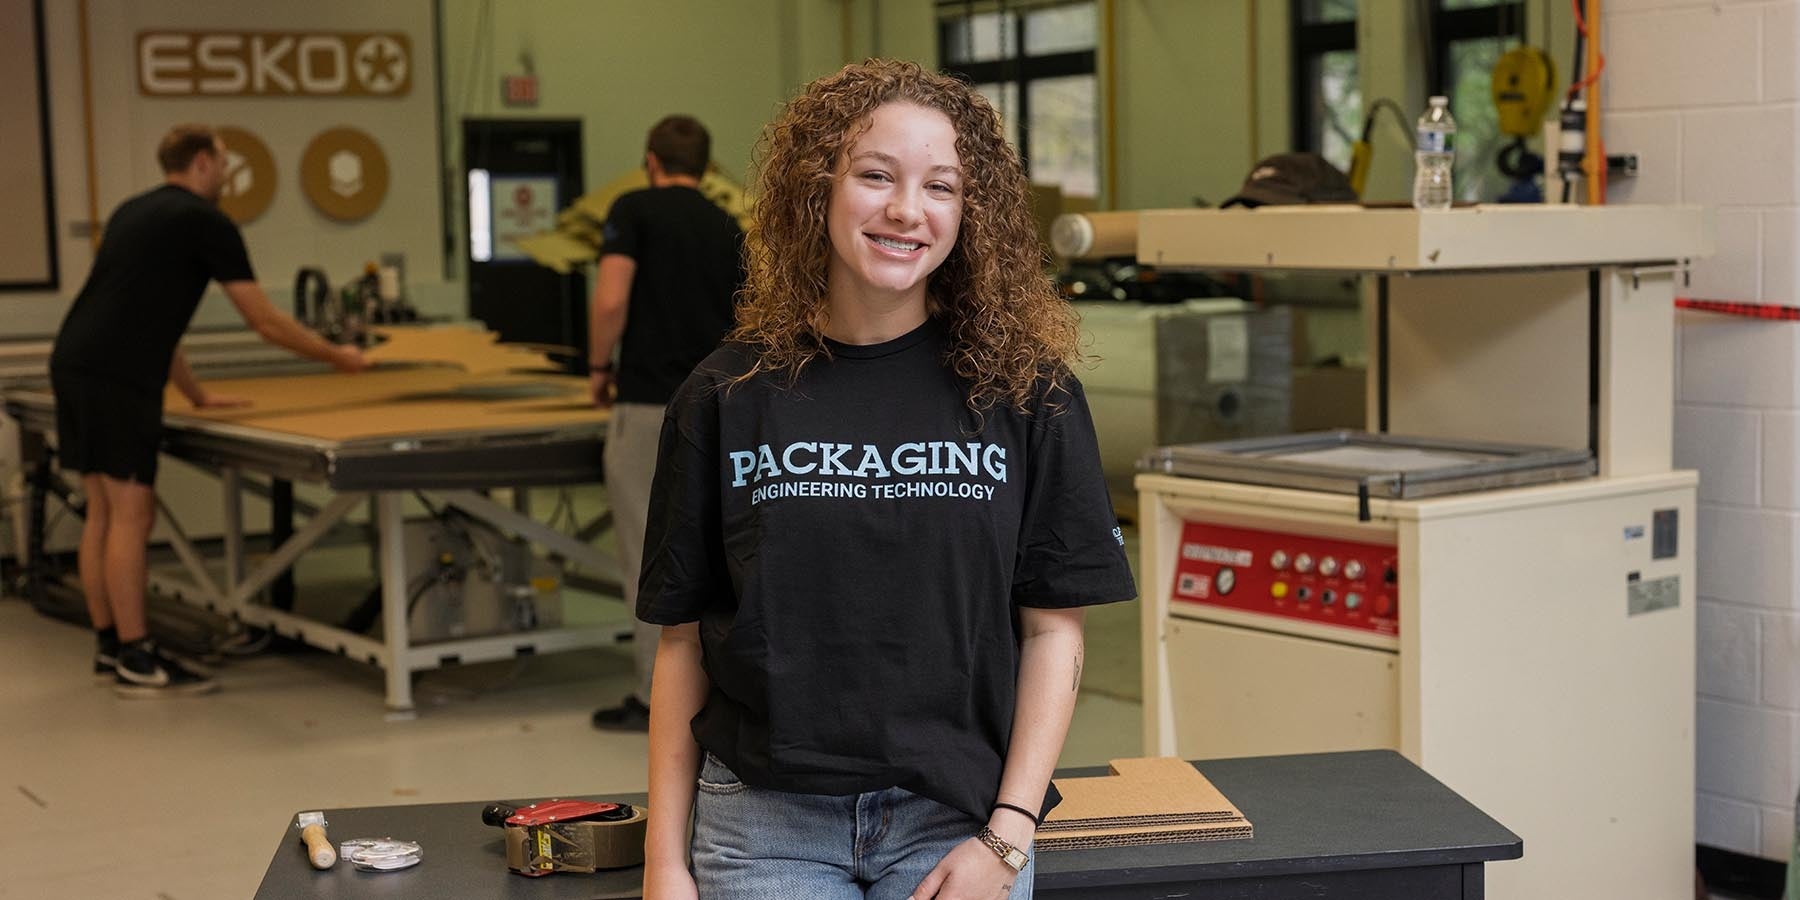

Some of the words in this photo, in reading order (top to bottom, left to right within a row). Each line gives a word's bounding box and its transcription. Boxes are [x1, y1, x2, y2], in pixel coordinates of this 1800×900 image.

[140, 35, 348, 93] ESKO
[729, 441, 1007, 488] PACKAGING
[751, 481, 867, 505] ENGINEERING
[871, 481, 995, 501] TECHNOLOGY
